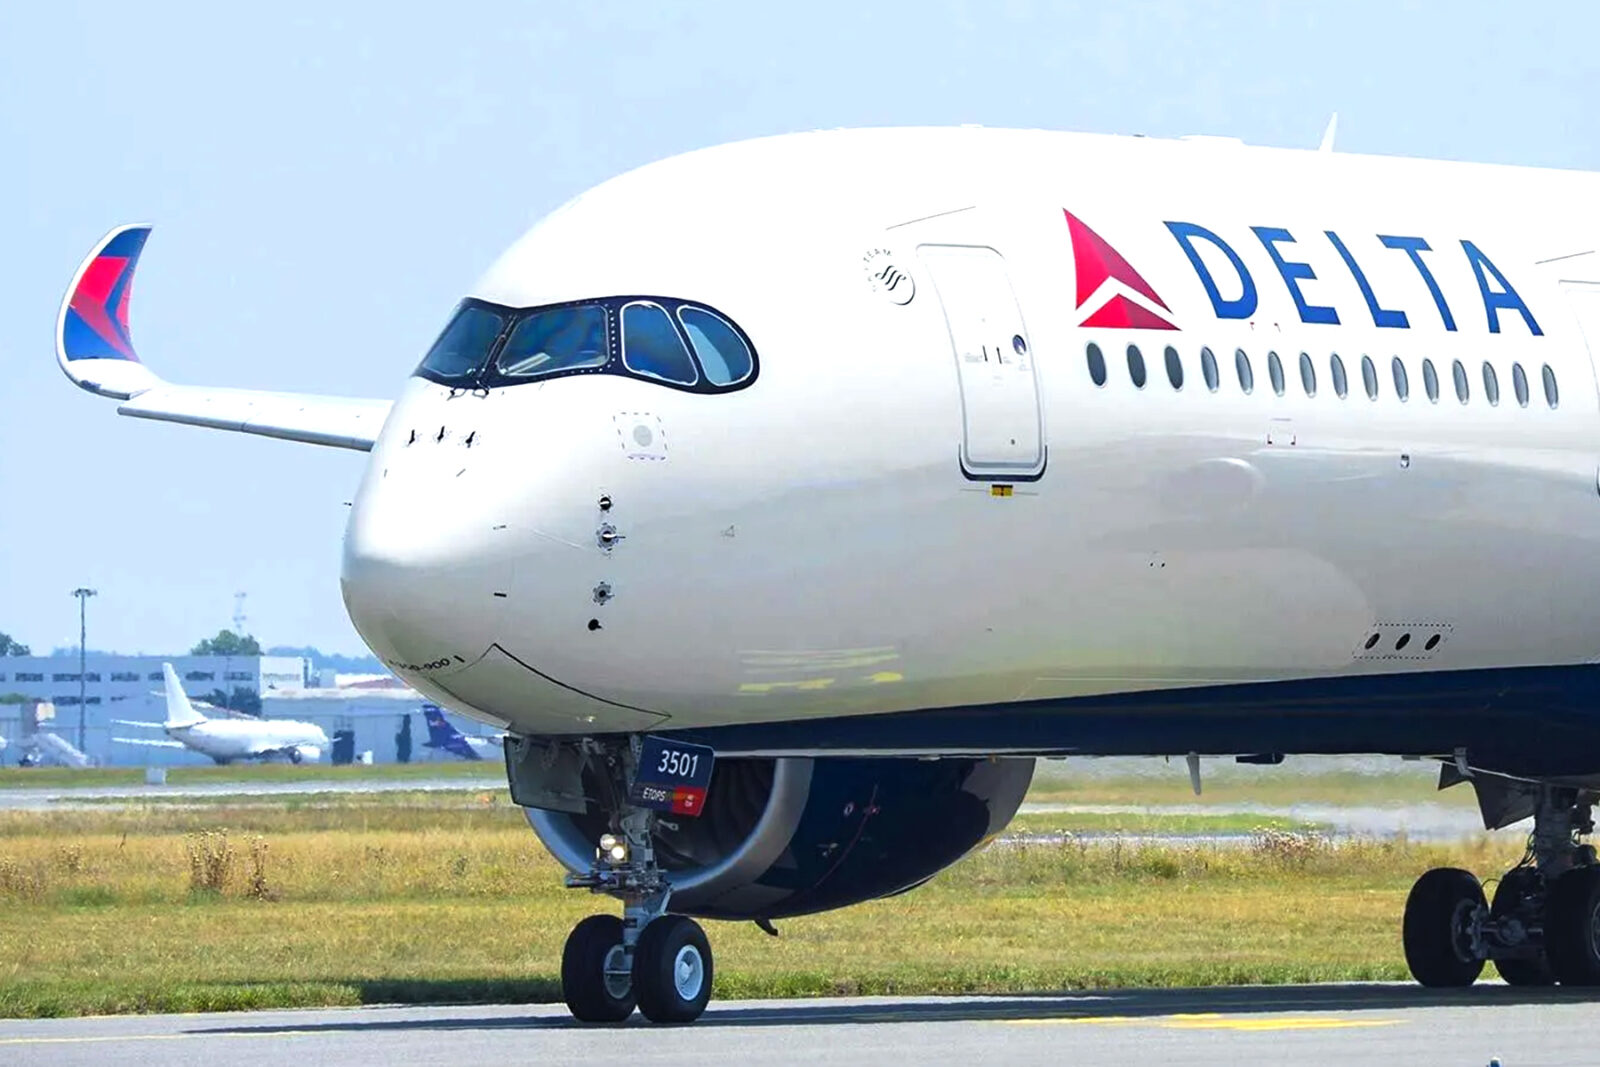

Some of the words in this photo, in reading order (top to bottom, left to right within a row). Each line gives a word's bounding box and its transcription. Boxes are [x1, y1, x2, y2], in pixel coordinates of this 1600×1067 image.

[1163, 220, 1545, 337] DELTA
[657, 749, 699, 778] 3501
[642, 787, 667, 802] ETOPS
